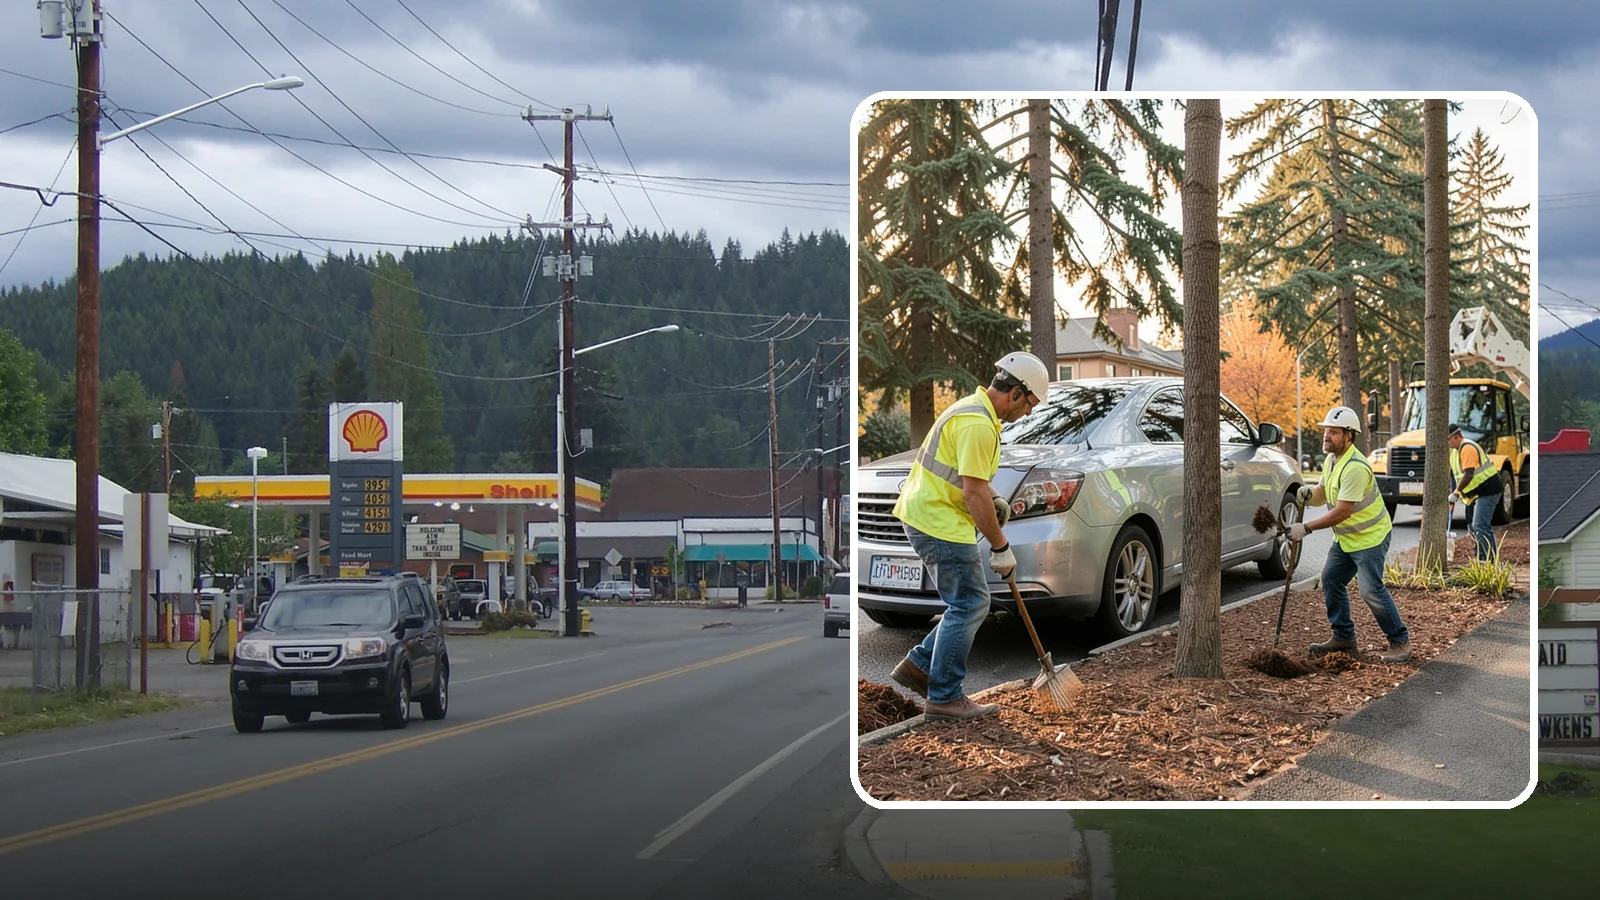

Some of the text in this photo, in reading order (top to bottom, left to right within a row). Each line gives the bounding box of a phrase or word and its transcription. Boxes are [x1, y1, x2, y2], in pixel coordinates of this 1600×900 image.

[366, 479, 384, 491] 395
[490, 484, 547, 499] Shell
[366, 494, 384, 504] 405
[366, 507, 384, 518] 415
[366, 521, 384, 533] 429
